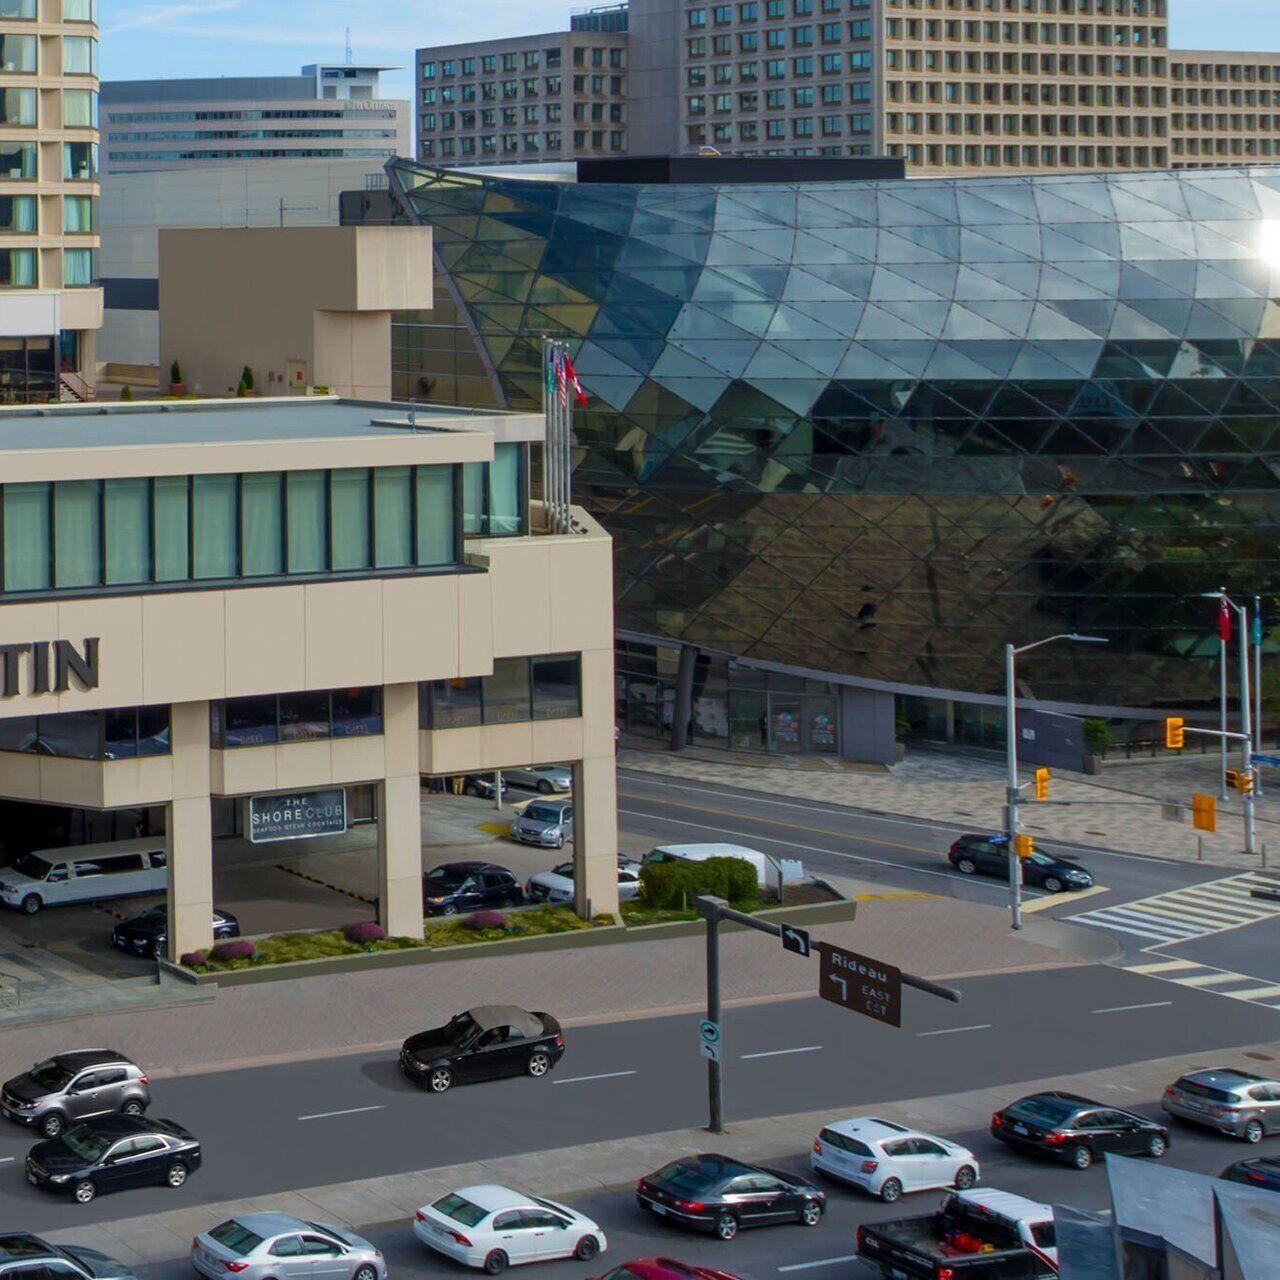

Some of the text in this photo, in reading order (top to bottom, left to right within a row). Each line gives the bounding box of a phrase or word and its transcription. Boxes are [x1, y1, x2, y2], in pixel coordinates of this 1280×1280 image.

[286, 798, 308, 807] THE
[832, 952, 887, 982] Rideau
[862, 984, 891, 1002] EAST
